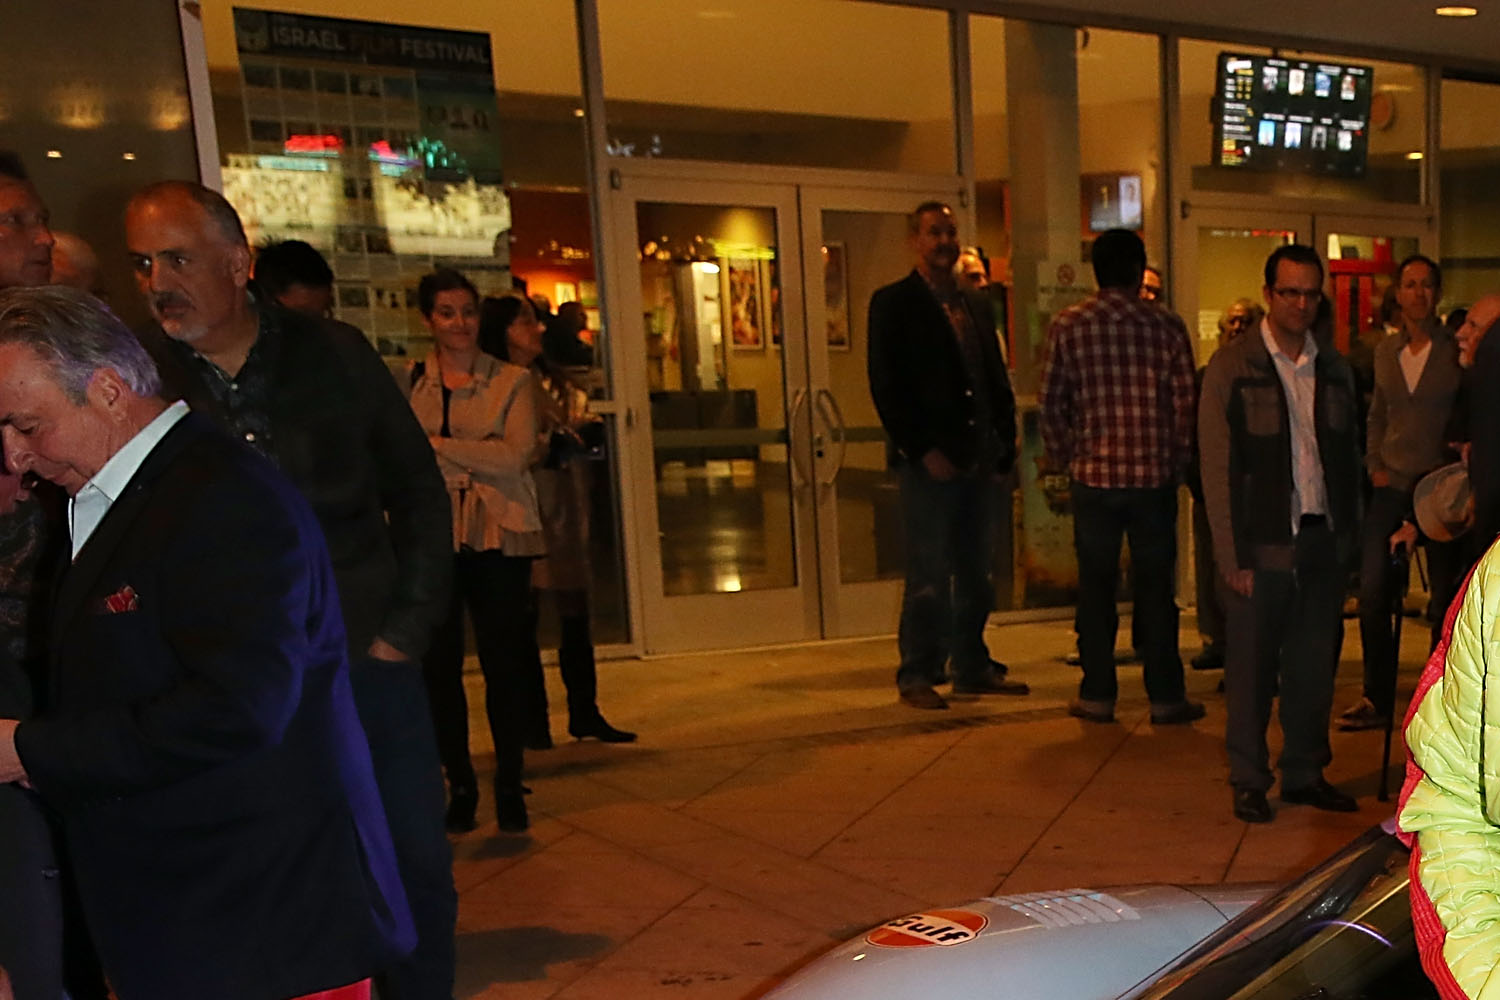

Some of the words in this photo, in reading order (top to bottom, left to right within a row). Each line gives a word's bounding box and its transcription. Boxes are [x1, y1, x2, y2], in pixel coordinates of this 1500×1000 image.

[272, 26, 345, 50] ISRAEL
[401, 39, 489, 64] FESTIVAL
[888, 915, 970, 942] Gulf
